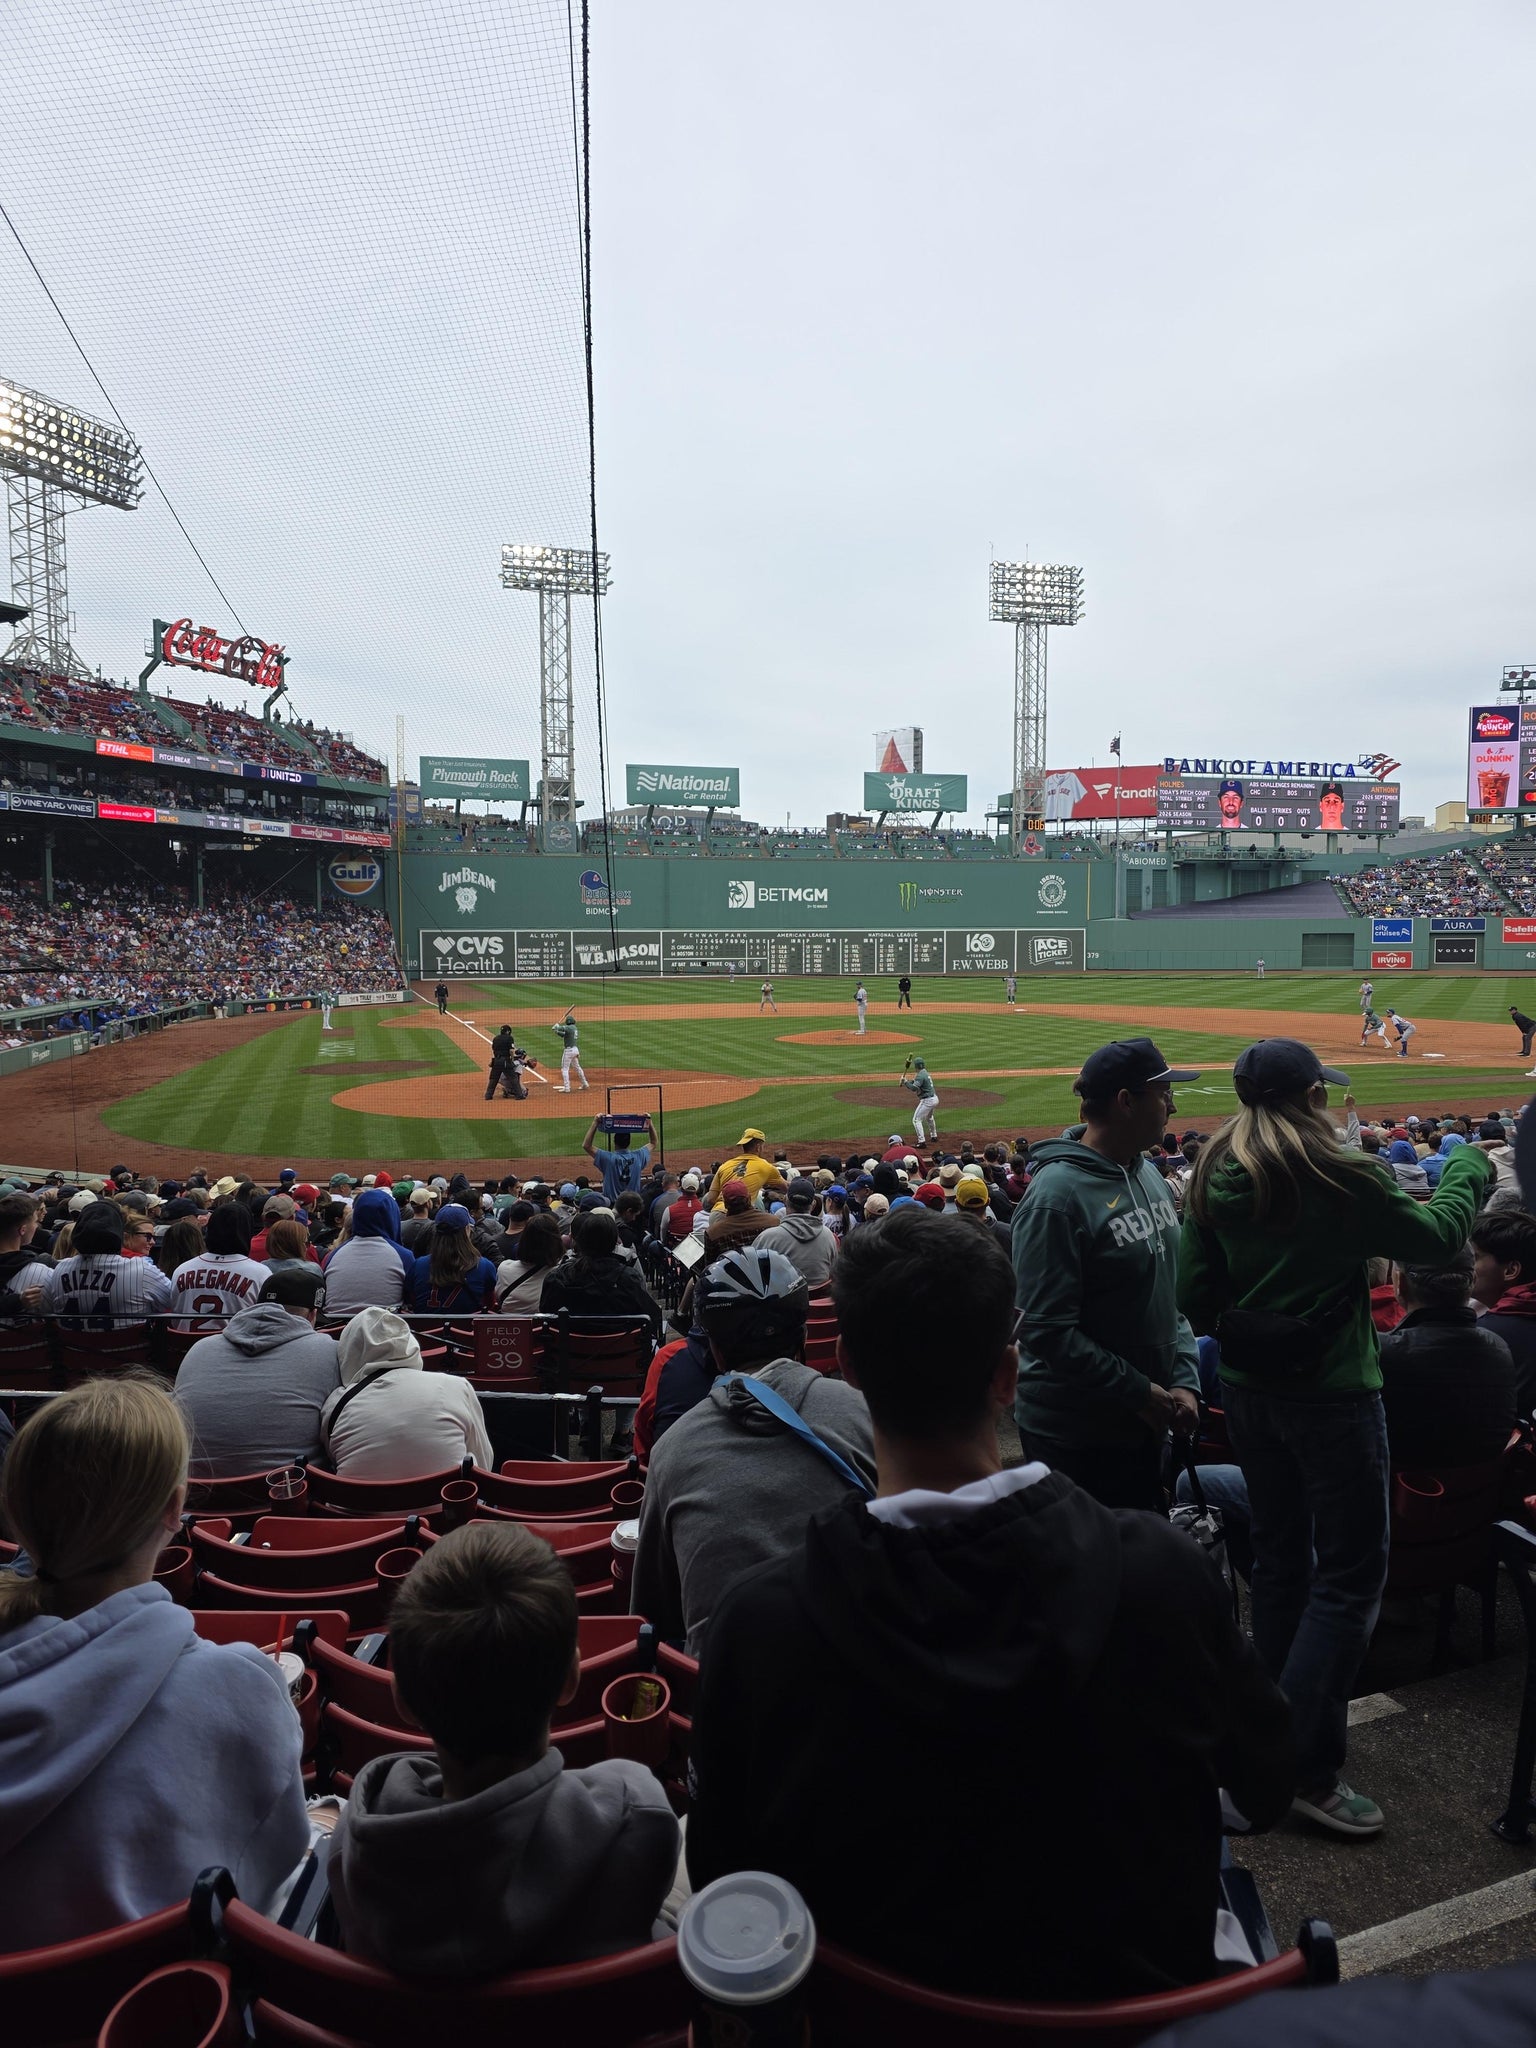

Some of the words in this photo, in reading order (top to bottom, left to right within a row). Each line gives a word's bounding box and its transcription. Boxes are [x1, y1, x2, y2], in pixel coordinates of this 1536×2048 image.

[1476, 722, 1515, 732] KRUNCHY
[99, 742, 129, 755] STIHL
[158, 753, 174, 762] PITCH
[174, 756, 191, 765] BREAK
[1164, 758, 1223, 774] BANK
[1231, 760, 1256, 775] OF
[1262, 761, 1356, 778] AMERICA
[270, 769, 302, 783] UNITED
[432, 768, 487, 783] Plymouth
[489, 770, 518, 783] Rock
[658, 774, 730, 792] National
[683, 792, 698, 801] Car
[700, 793, 728, 801] Rental
[889, 786, 941, 800] DRAFT
[1114, 785, 1157, 800] Fanati
[21, 799, 65, 810] VINEYARD
[67, 803, 92, 813] VINES
[896, 798, 941, 810] KINGS
[1255, 816, 1262, 826] 0
[1278, 816, 1285, 826] 0
[1300, 816, 1307, 827] 0
[1128, 857, 1167, 866] ABIOMED
[330, 864, 377, 879] Gulf
[758, 887, 828, 902] BETMGM
[919, 887, 964, 896] MONSTER
[586, 907, 611, 915] BIDMC
[1375, 925, 1388, 933] city
[1375, 929, 1401, 937] cruises
[456, 936, 504, 955] CVS
[966, 933, 996, 952] 160
[1037, 938, 1068, 951] ACE
[1038, 949, 1068, 959] TICKET
[1377, 956, 1406, 964] IRVING
[435, 957, 504, 975] Health
[952, 959, 973, 970] F.W.
[975, 959, 1009, 970] WEBB
[1108, 1208, 1154, 1247] RED
[61, 1270, 116, 1294] RIZZO
[177, 1269, 253, 1298] BREGMAN
[190, 1295, 224, 1331] 2
[486, 1327, 521, 1336] FIELD
[491, 1338, 516, 1346] BOX
[486, 1351, 523, 1369] 39
